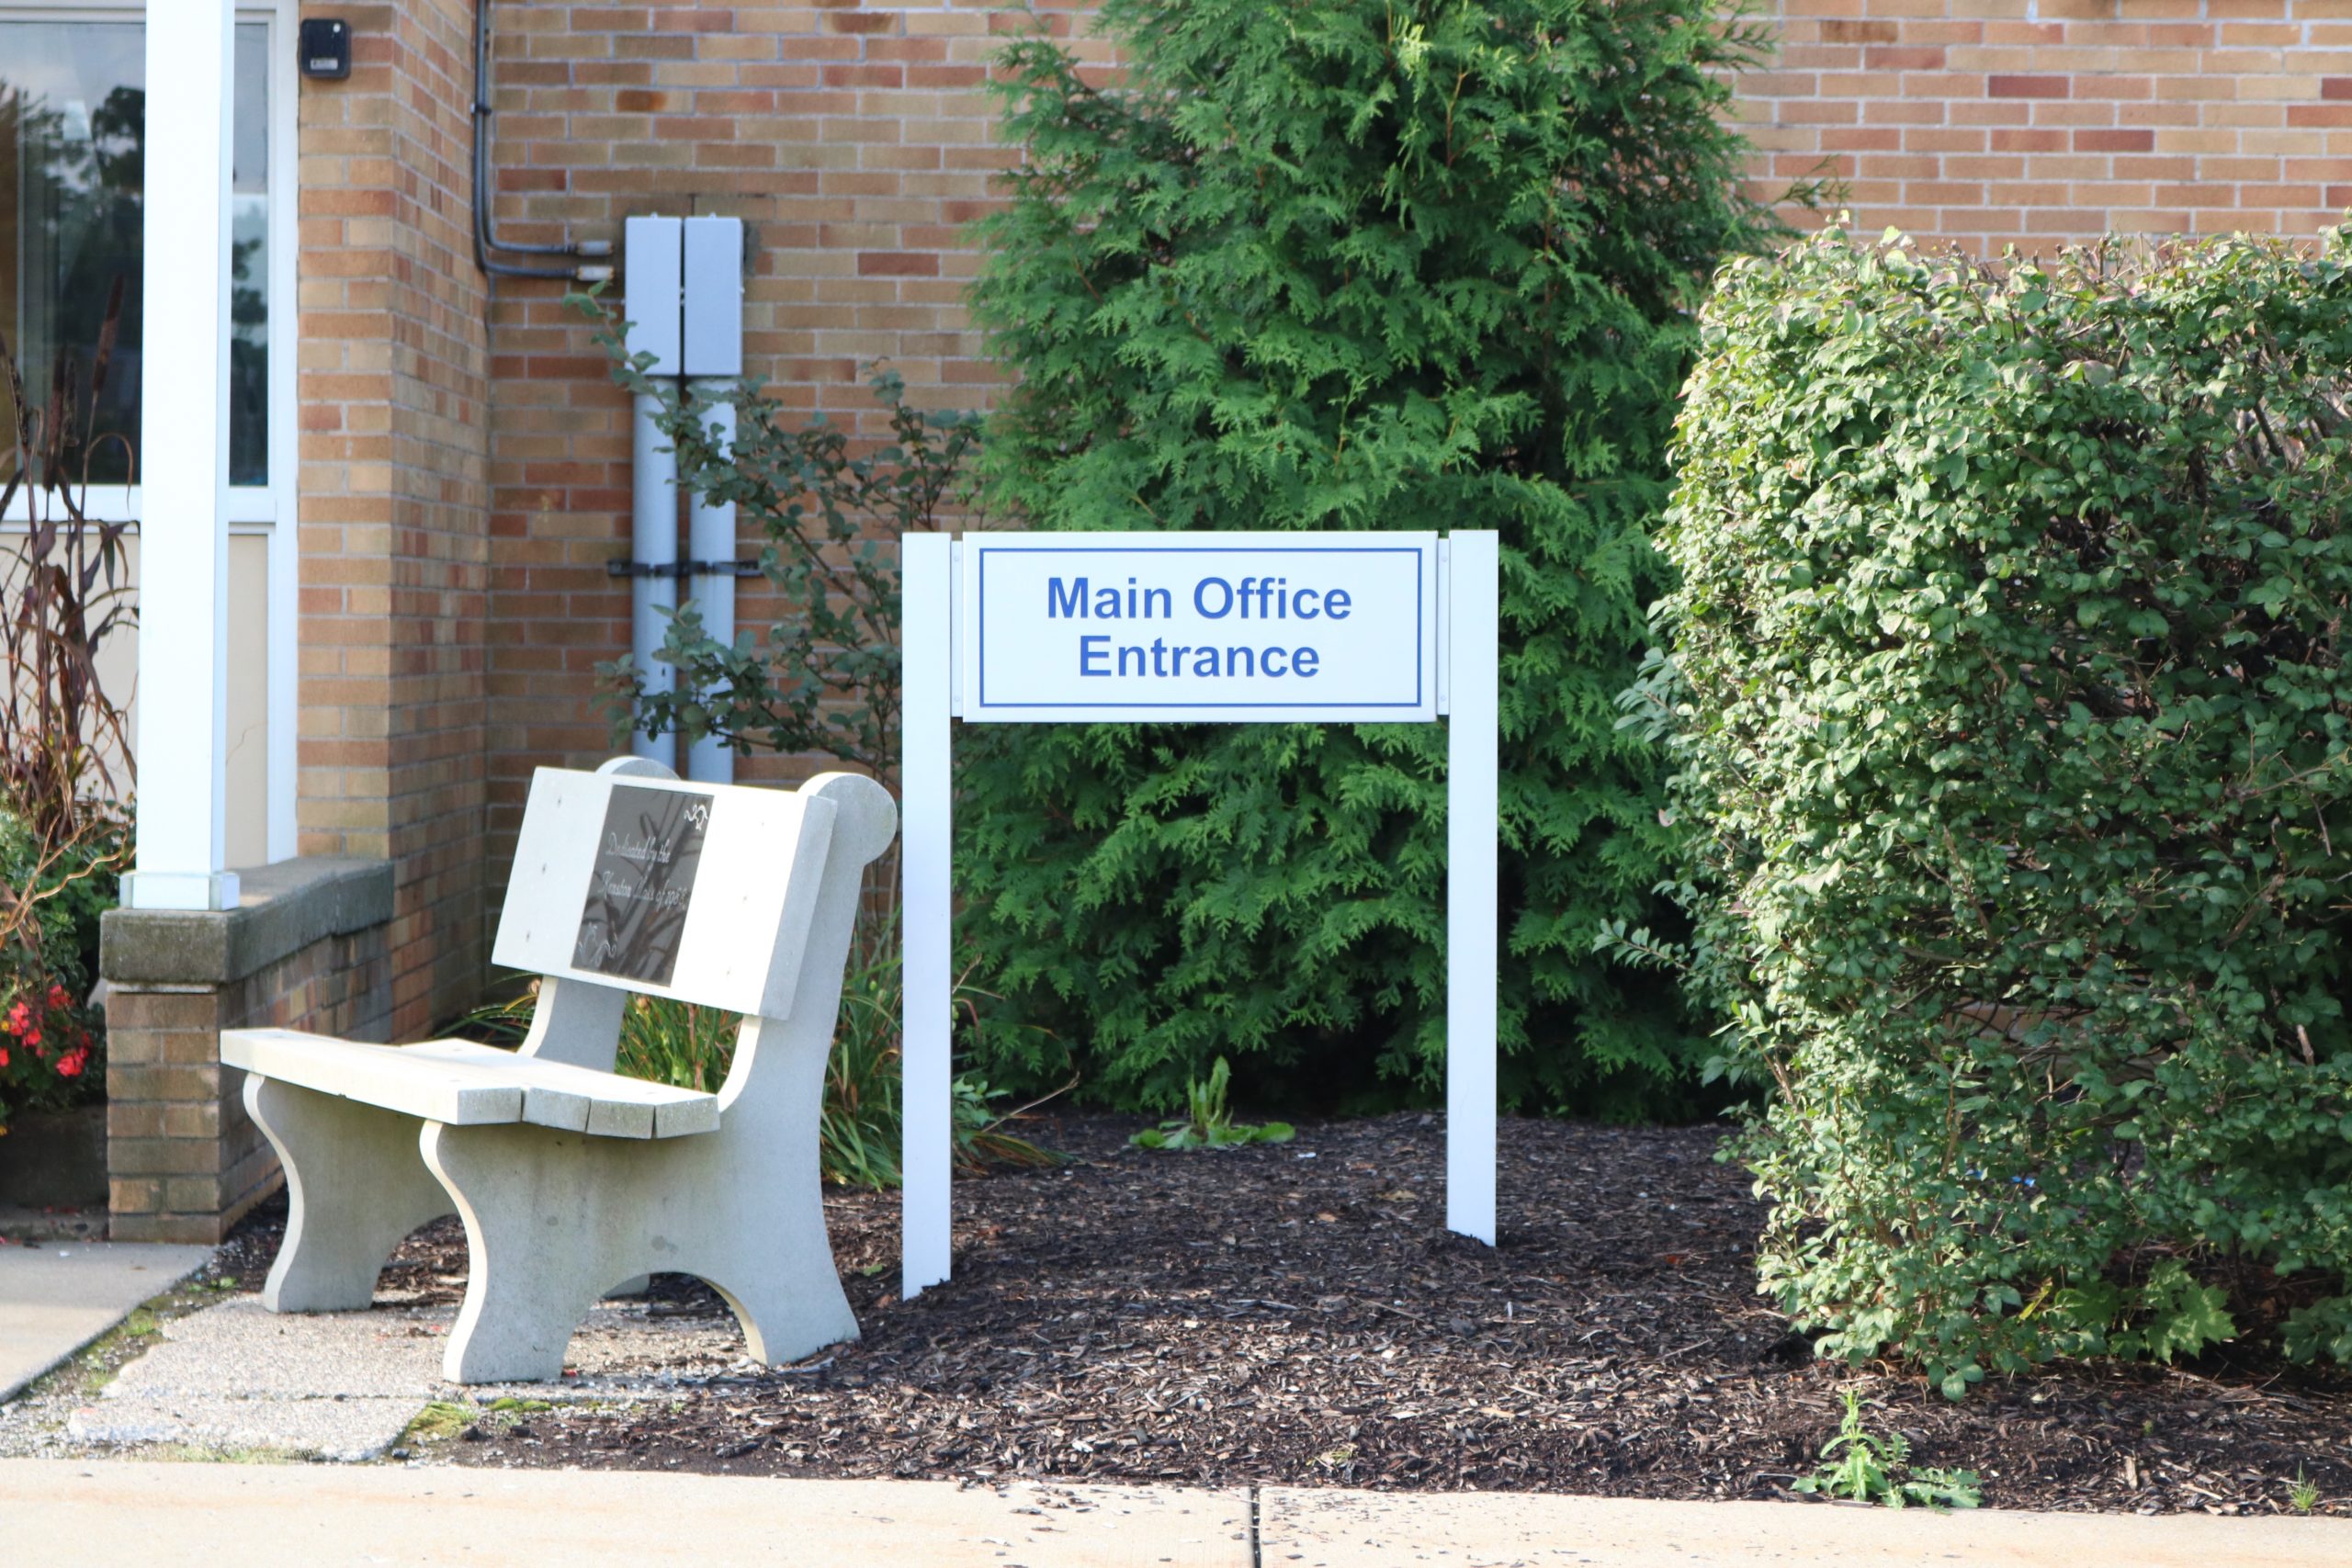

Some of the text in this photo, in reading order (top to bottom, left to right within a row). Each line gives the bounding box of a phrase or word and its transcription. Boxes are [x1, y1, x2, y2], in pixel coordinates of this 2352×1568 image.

[1047, 576, 1352, 620] Main Office
[1080, 634, 1320, 678] Entrance
[605, 832, 671, 872] Dedicated by the
[654, 879, 670, 912] of
